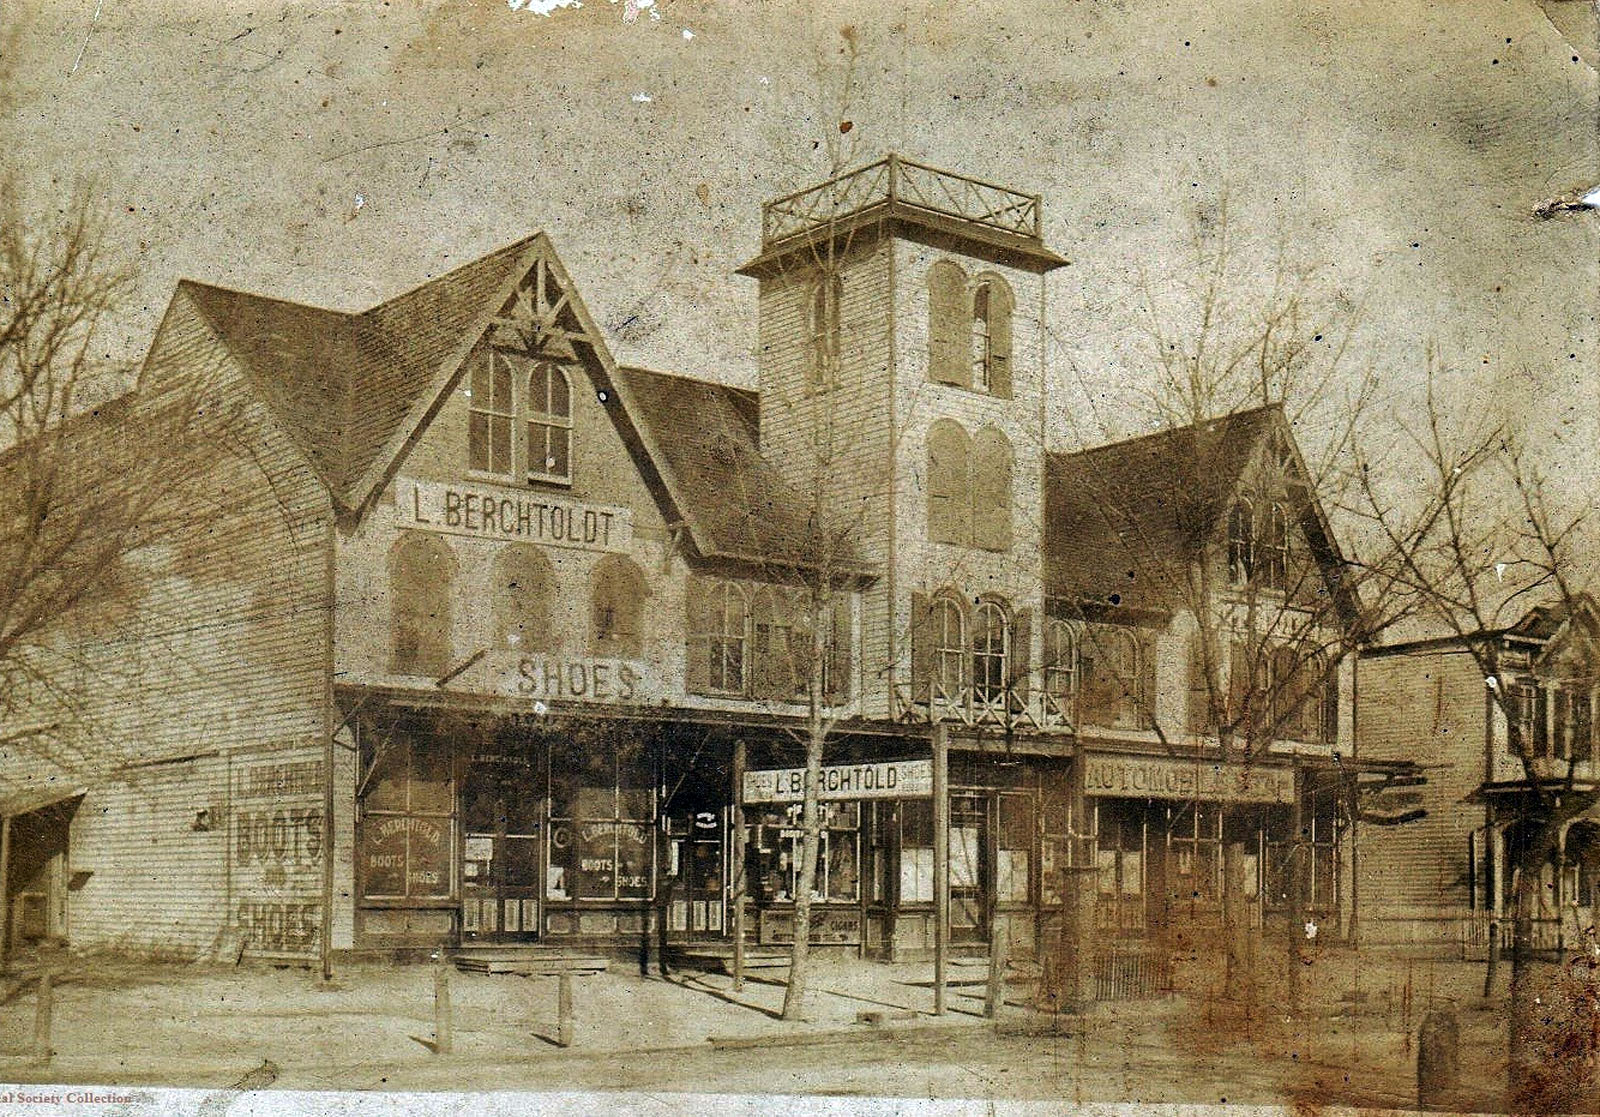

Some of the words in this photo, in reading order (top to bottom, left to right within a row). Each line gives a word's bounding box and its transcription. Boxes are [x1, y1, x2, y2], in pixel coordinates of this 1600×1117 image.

[518, 659, 635, 700] SHOES
[236, 809, 321, 865] BOOTS
[370, 855, 405, 868] BOOTS
[581, 859, 613, 872] BOOTS
[617, 875, 648, 888] SHOES
[830, 920, 859, 932] CIGARS
